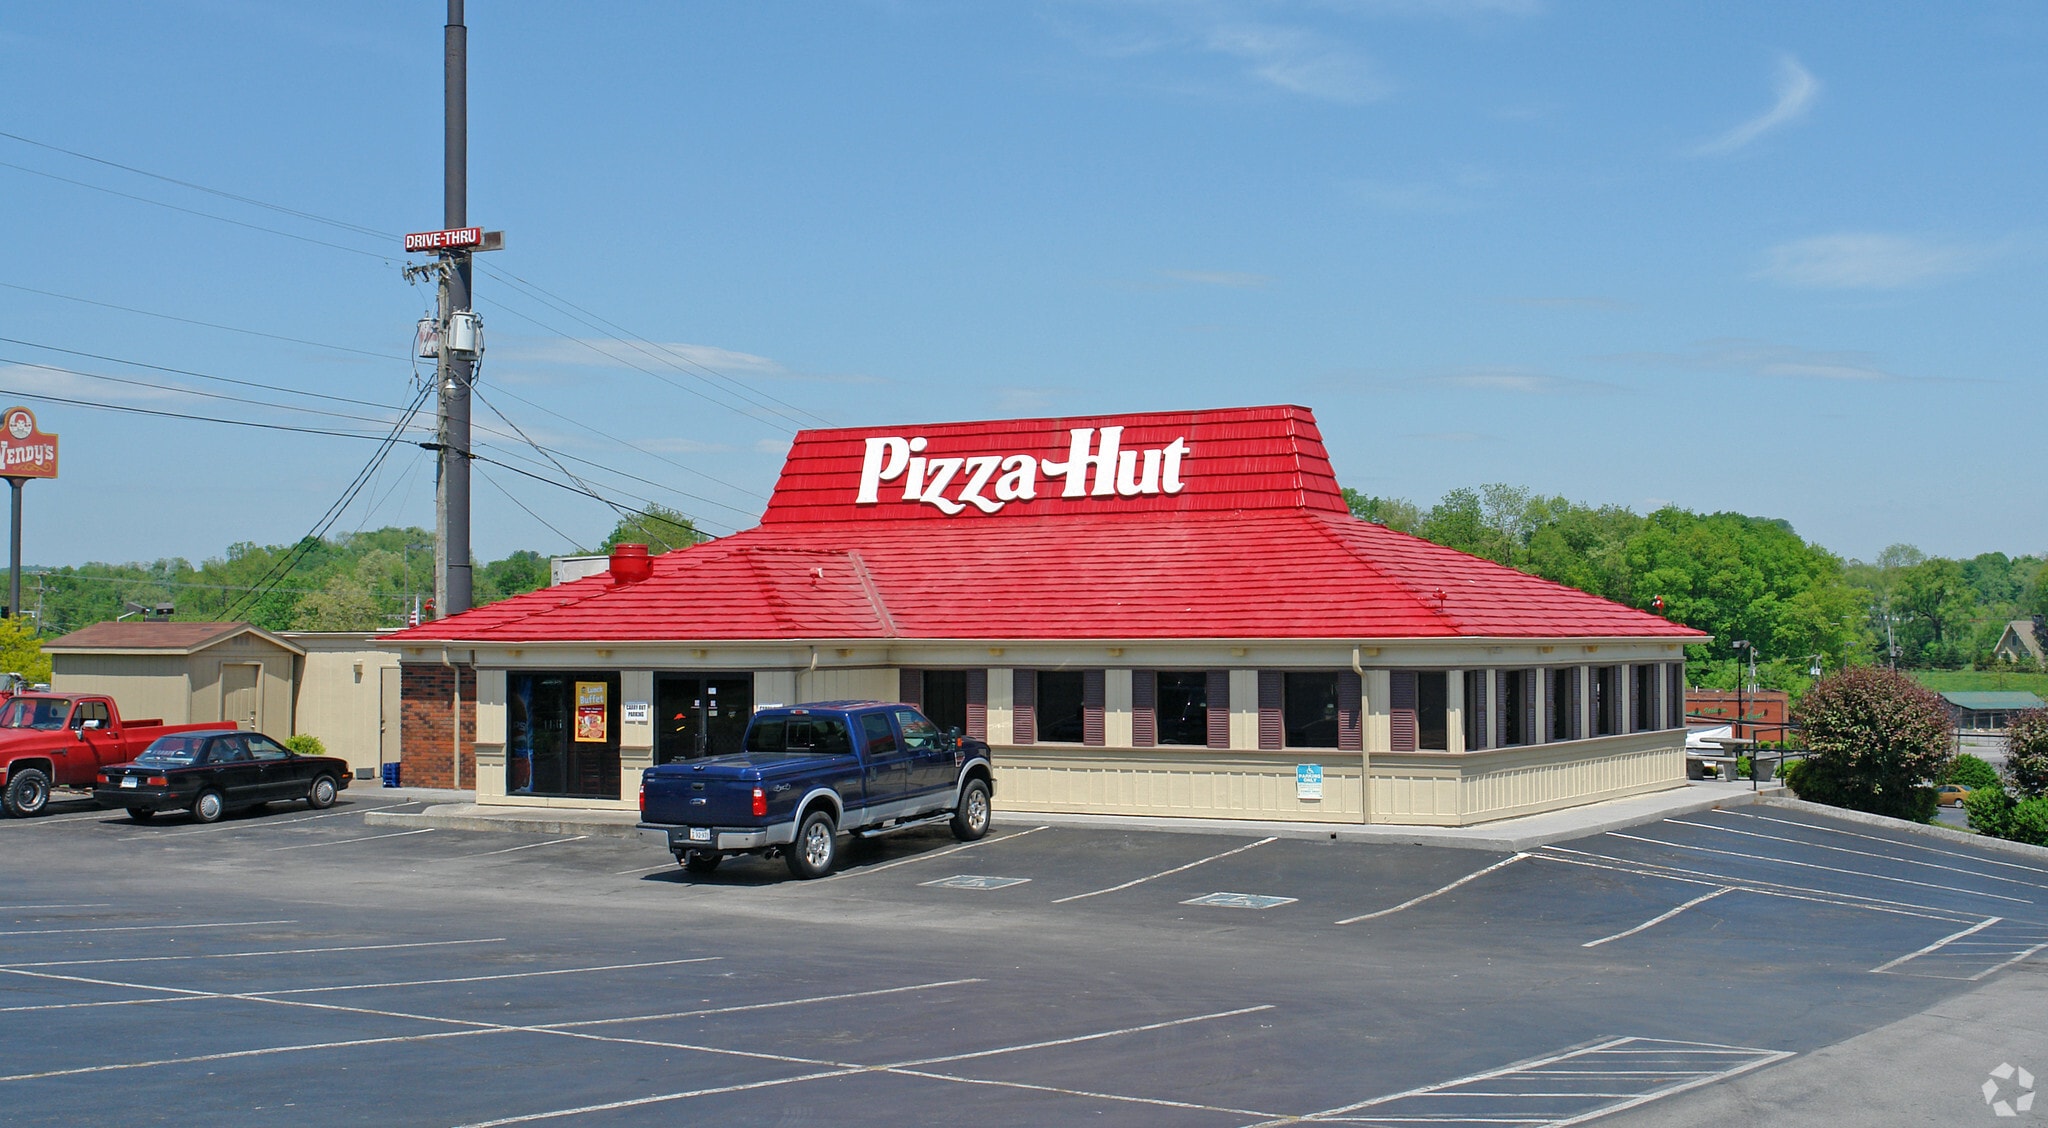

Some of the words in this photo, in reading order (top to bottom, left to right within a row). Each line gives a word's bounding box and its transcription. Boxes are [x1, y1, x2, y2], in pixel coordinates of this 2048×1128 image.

[406, 229, 477, 249] DRIVE-THRU
[855, 436, 1037, 515] Pizza
[1041, 426, 1191, 497] Hut
[580, 695, 604, 704] Buffet
